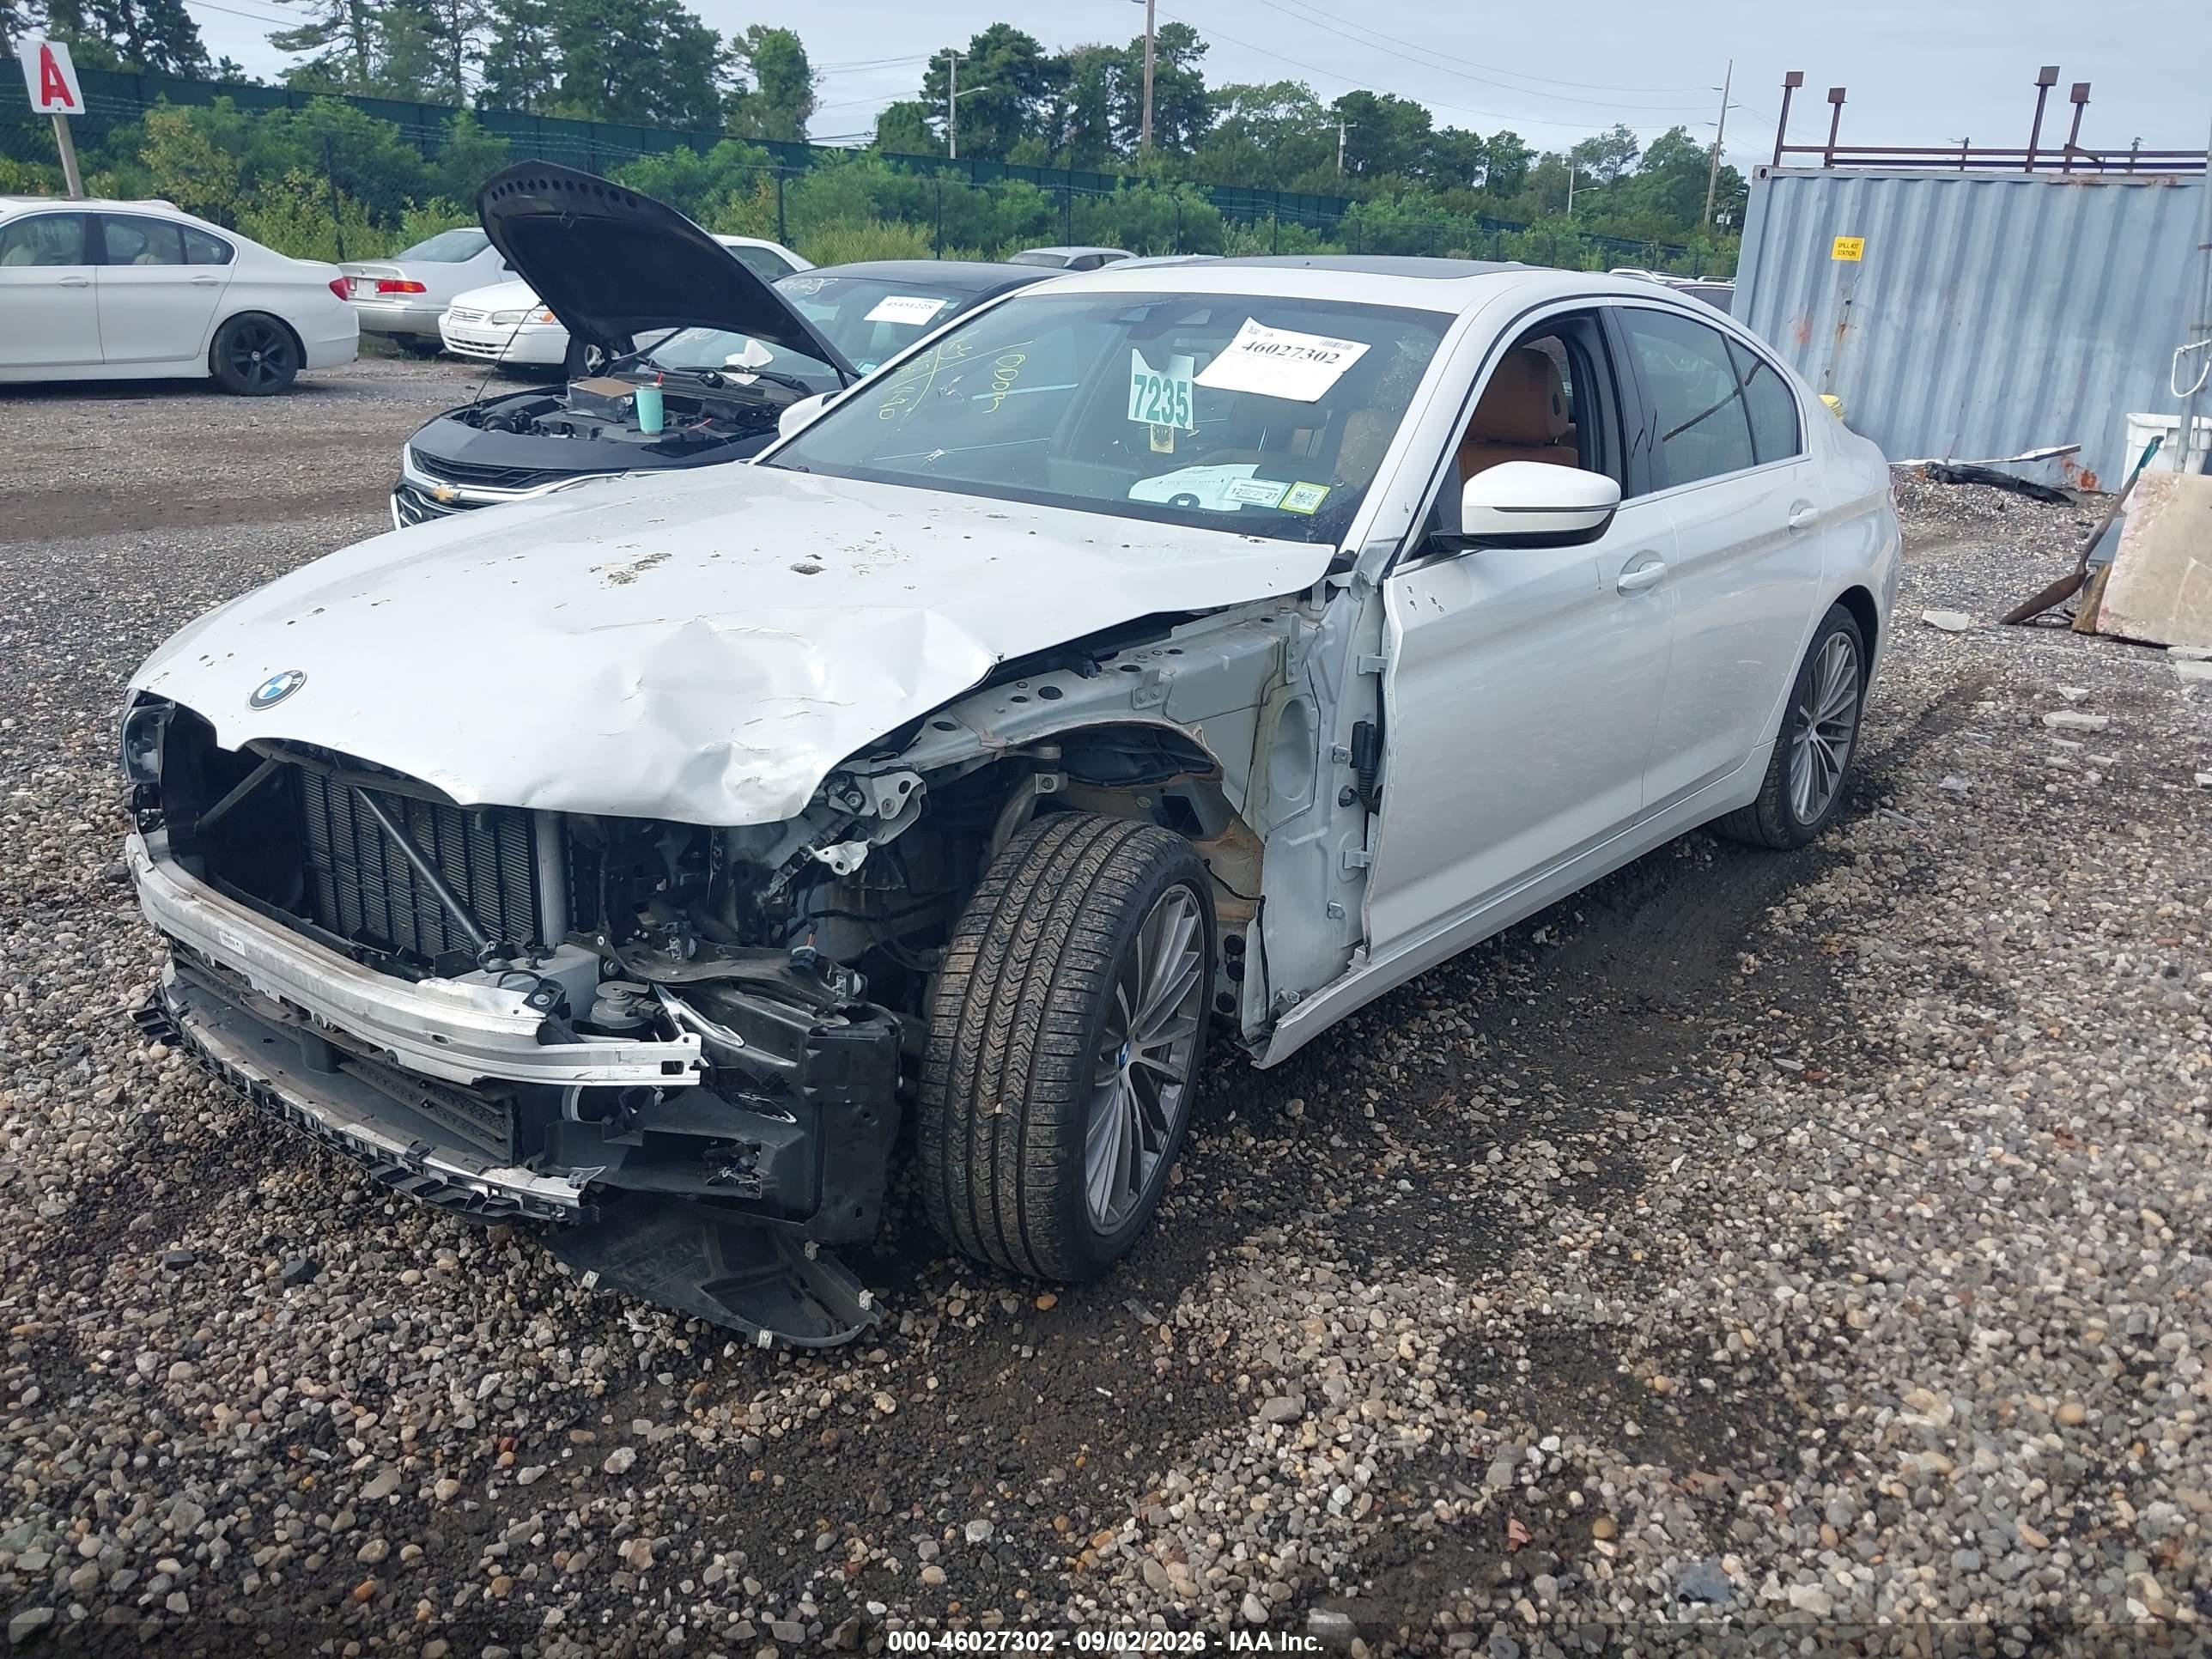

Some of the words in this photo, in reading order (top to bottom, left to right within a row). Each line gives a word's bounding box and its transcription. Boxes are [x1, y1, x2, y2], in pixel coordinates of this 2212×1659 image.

[40, 46, 75, 106] A
[1242, 341, 1340, 364] 46027302
[1133, 374, 1189, 427] 7235
